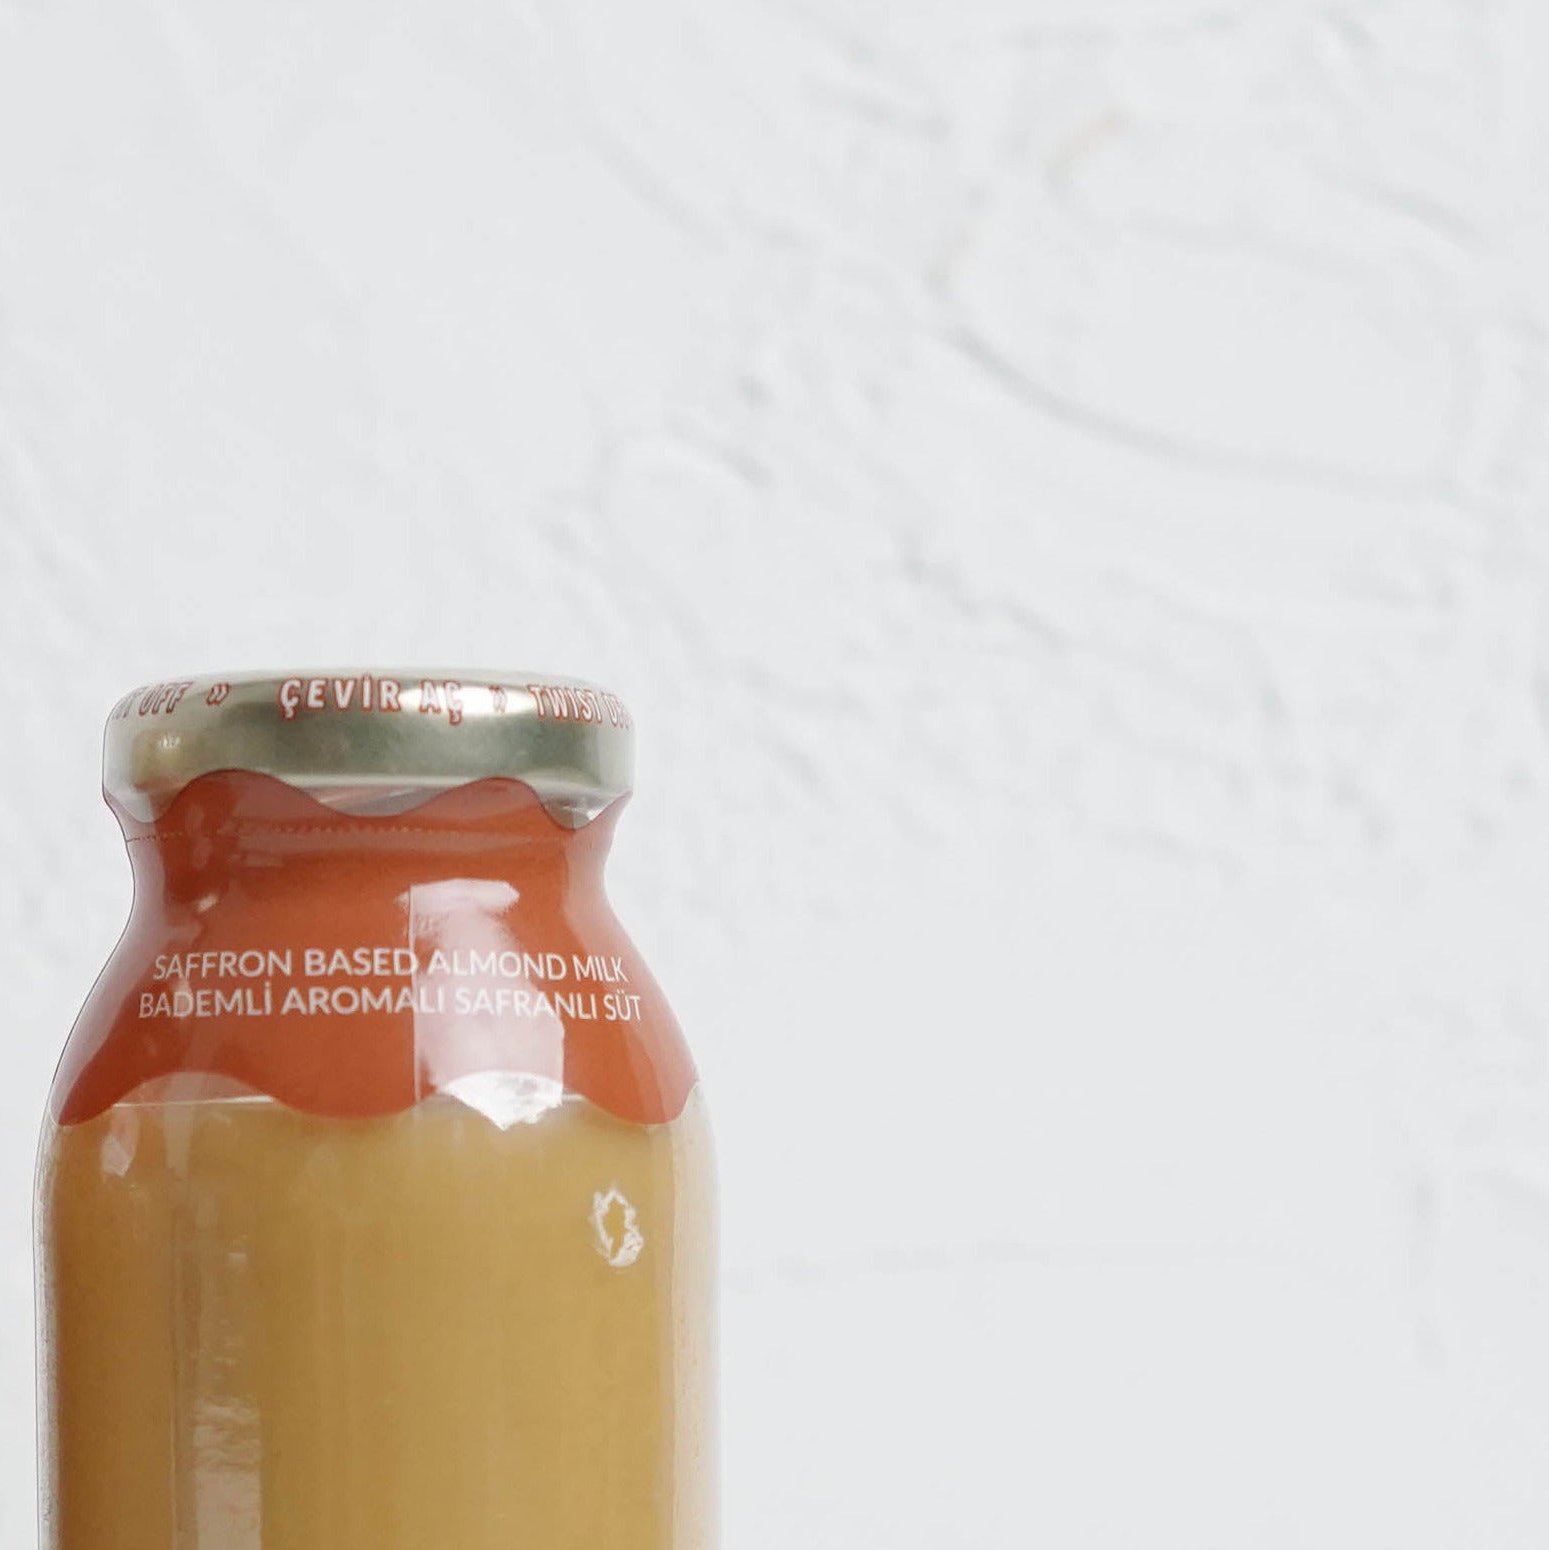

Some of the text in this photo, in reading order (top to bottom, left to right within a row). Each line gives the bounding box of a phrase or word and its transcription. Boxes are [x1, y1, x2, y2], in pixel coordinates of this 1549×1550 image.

[279, 672, 402, 721] ÇEVİR
[419, 679, 464, 726] AÇ
[526, 683, 603, 724] TWIST
[152, 947, 630, 984] SAFFRON BASED ALMOND MILK
[138, 981, 642, 1023] BADEMLİ AROMALI SAFRANLI SÜT
